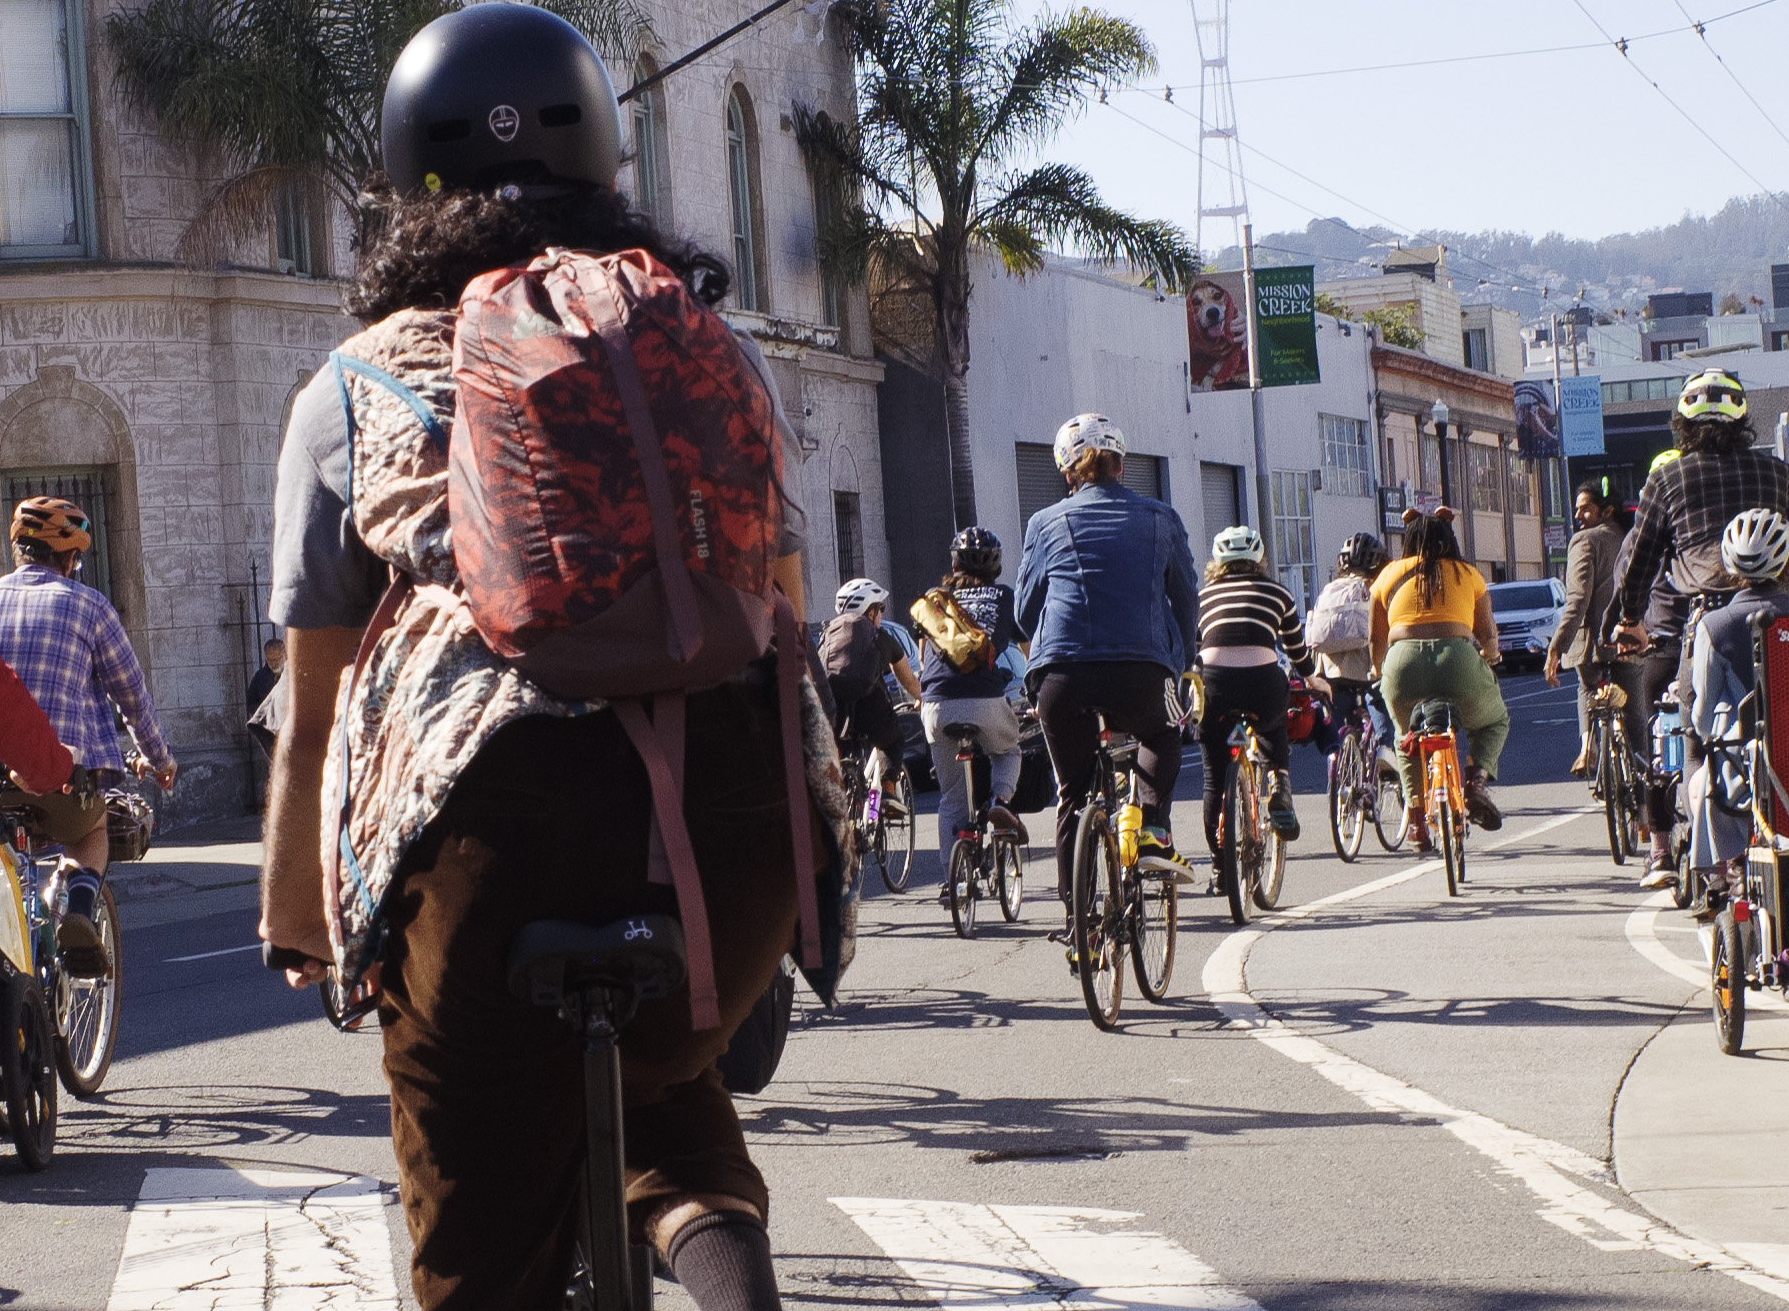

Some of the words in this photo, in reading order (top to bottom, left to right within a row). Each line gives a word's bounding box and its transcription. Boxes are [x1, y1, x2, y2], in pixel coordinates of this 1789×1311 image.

[1258, 283, 1311, 299] MISSION
[1258, 297, 1312, 316] CREEK
[1563, 397, 1600, 409] CREEK
[690, 490, 708, 539] FLASH
[697, 542, 709, 558] 18
